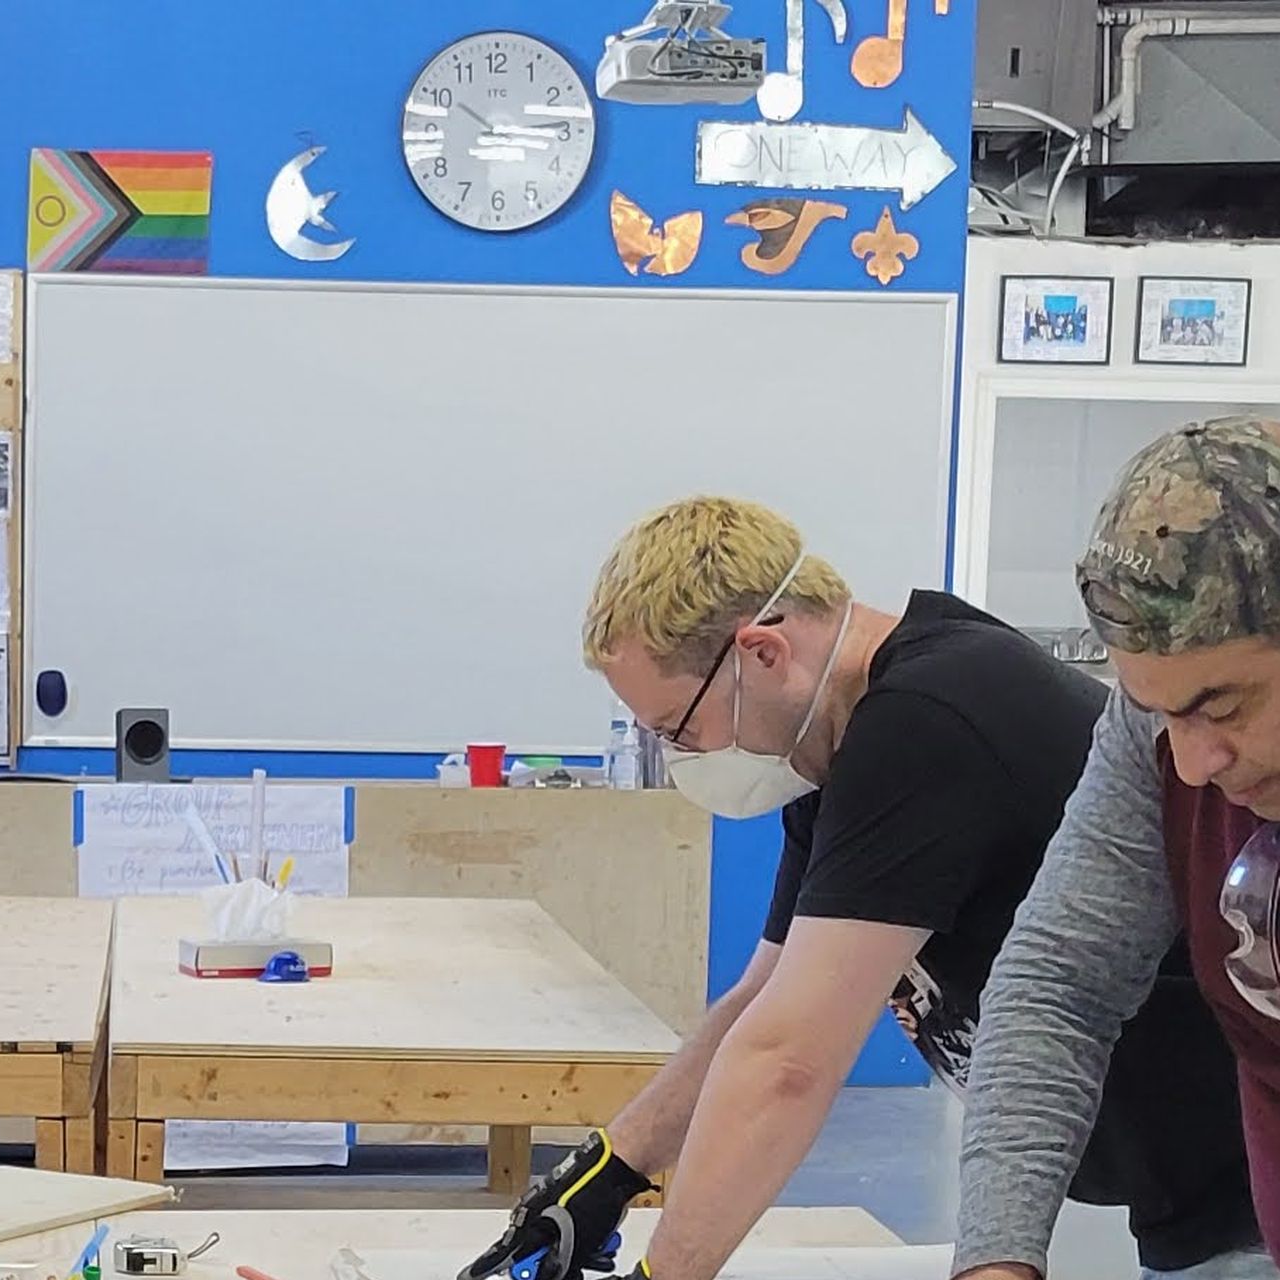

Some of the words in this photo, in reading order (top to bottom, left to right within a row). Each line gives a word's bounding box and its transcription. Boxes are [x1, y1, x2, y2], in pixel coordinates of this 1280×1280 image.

[454, 62, 473, 83] 11
[485, 52, 508, 74] 12
[526, 62, 534, 82] 1
[430, 88, 452, 108] 10
[546, 86, 561, 107] 2
[557, 120, 571, 142] 3
[434, 157, 448, 178] 8
[818, 138, 919, 178] WAY
[458, 181, 472, 202] 7
[491, 190, 505, 211] 6
